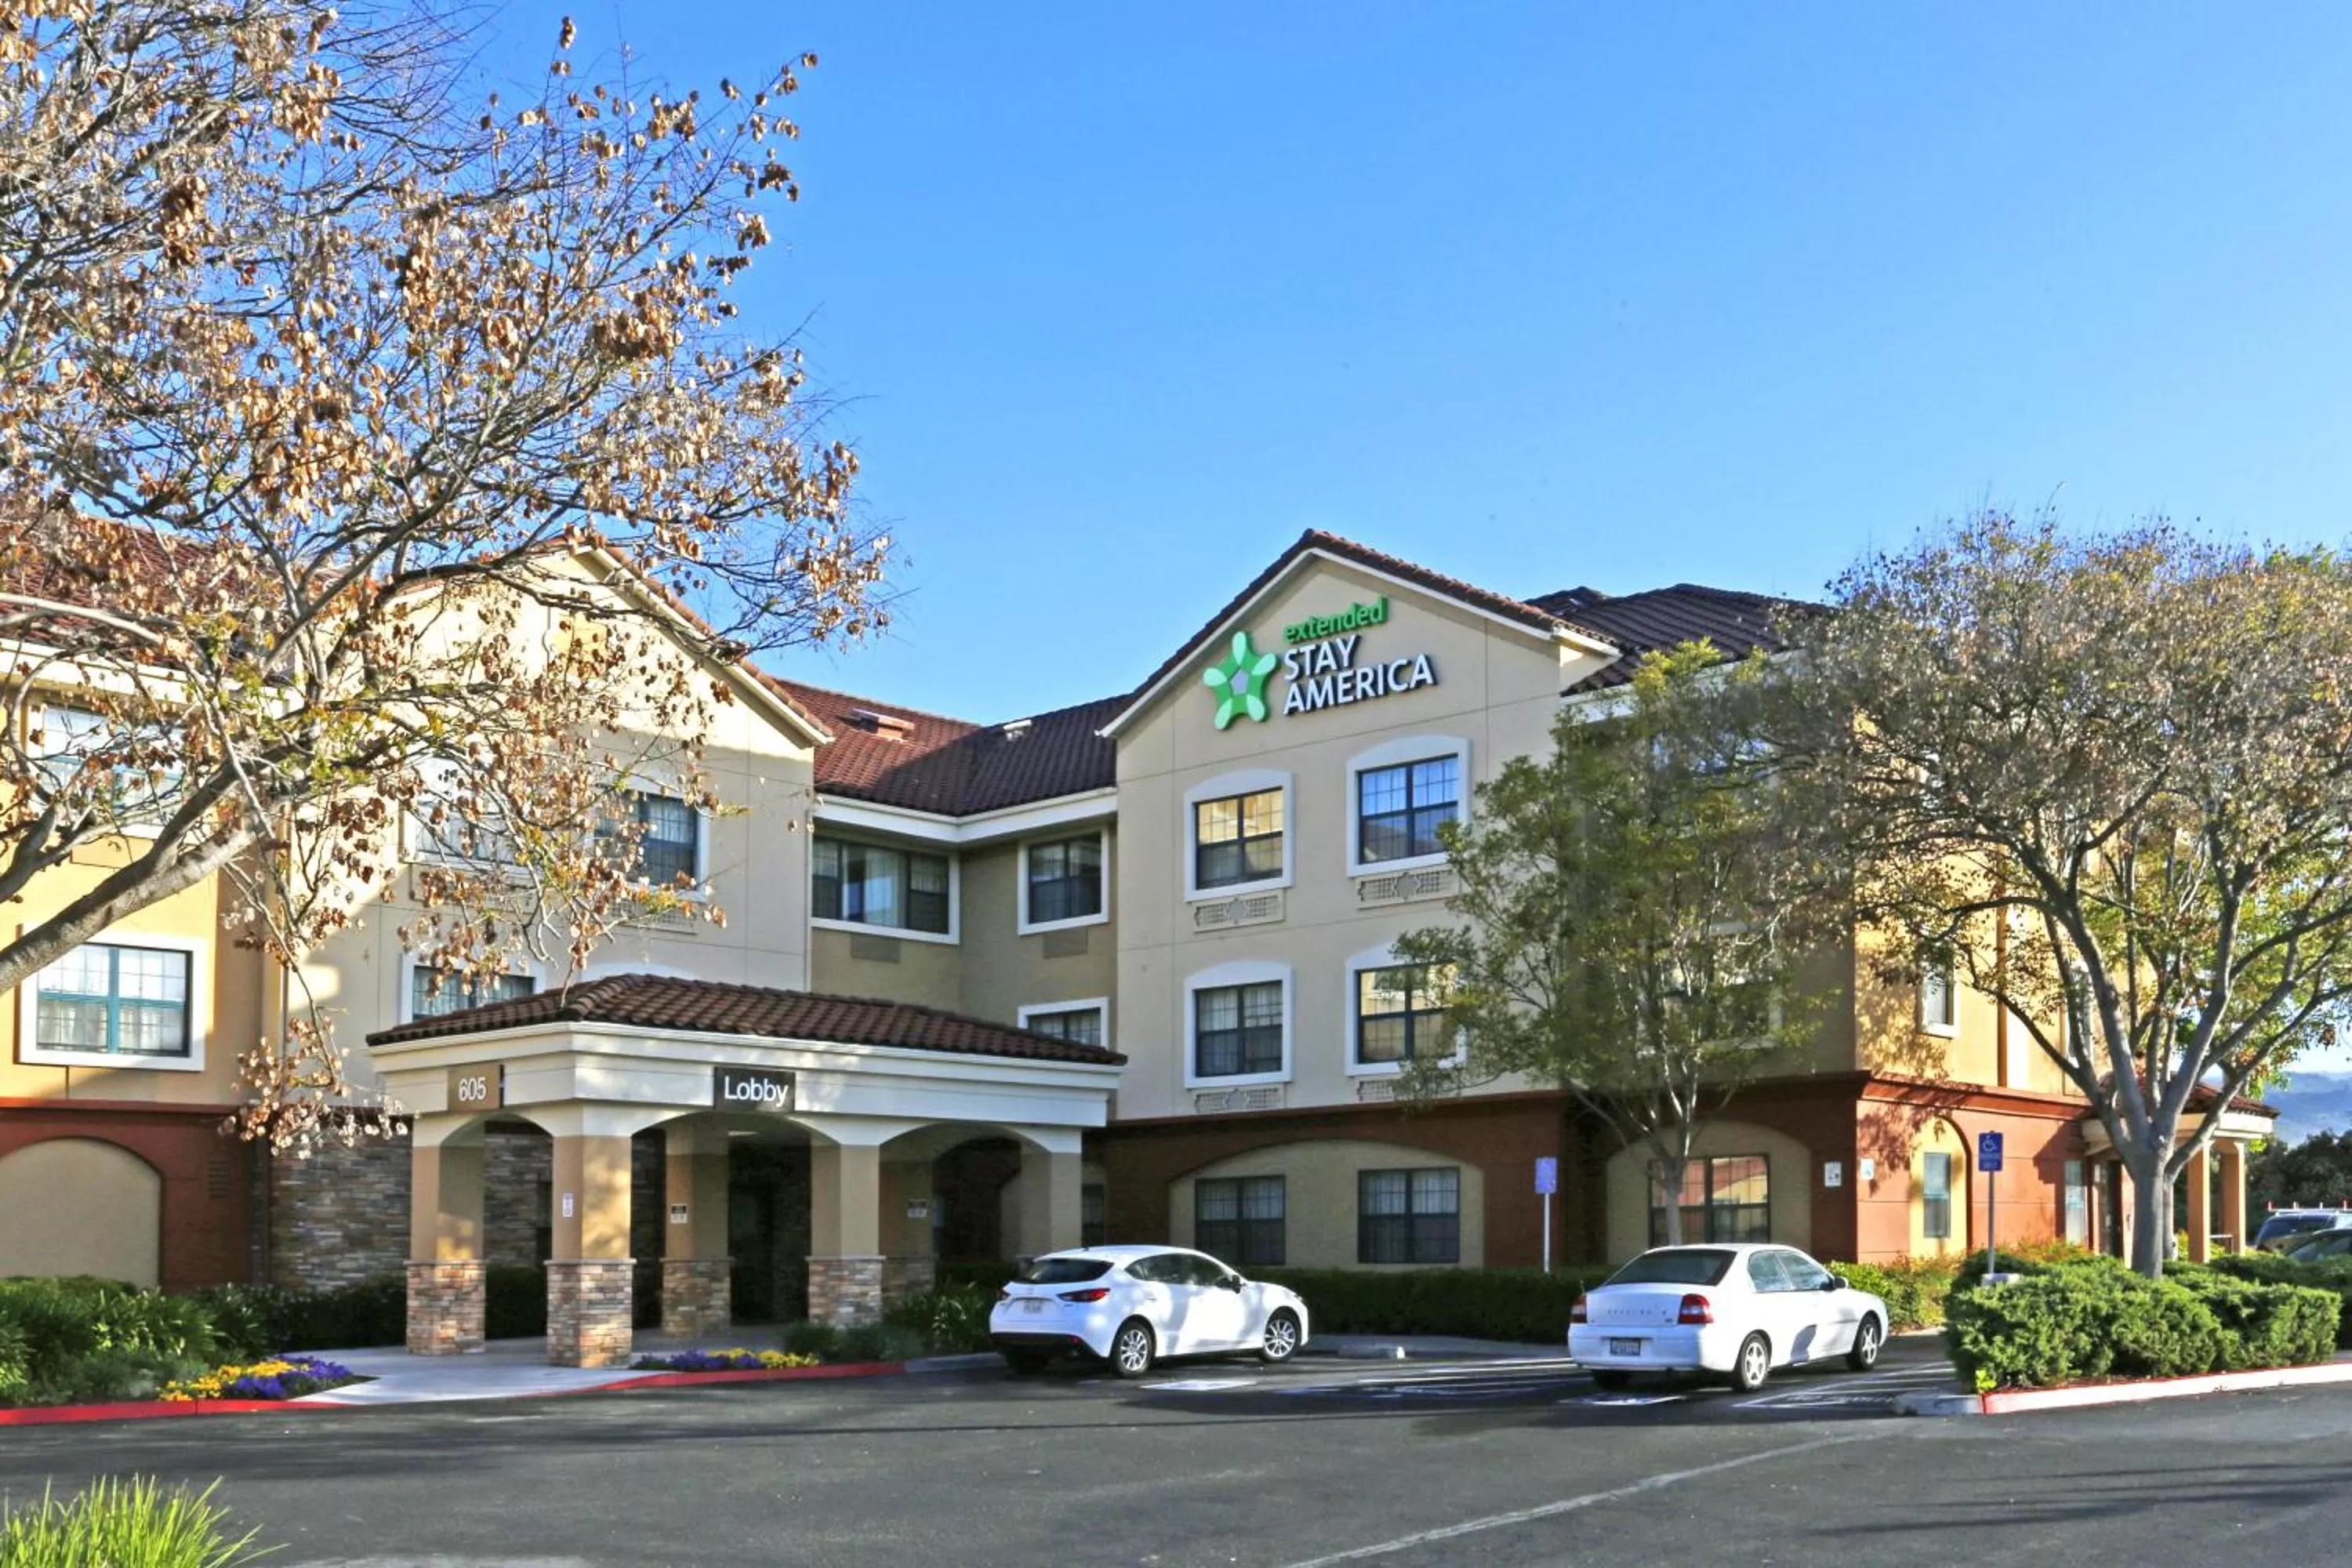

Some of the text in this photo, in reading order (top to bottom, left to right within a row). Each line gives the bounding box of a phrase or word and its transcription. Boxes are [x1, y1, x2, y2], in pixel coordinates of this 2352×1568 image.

[1283, 594, 1388, 644] extended
[1283, 633, 1360, 682] STAY
[1283, 653, 1438, 716] AMERICA
[458, 1076, 487, 1102] 605
[724, 1075, 789, 1108] Lobby
